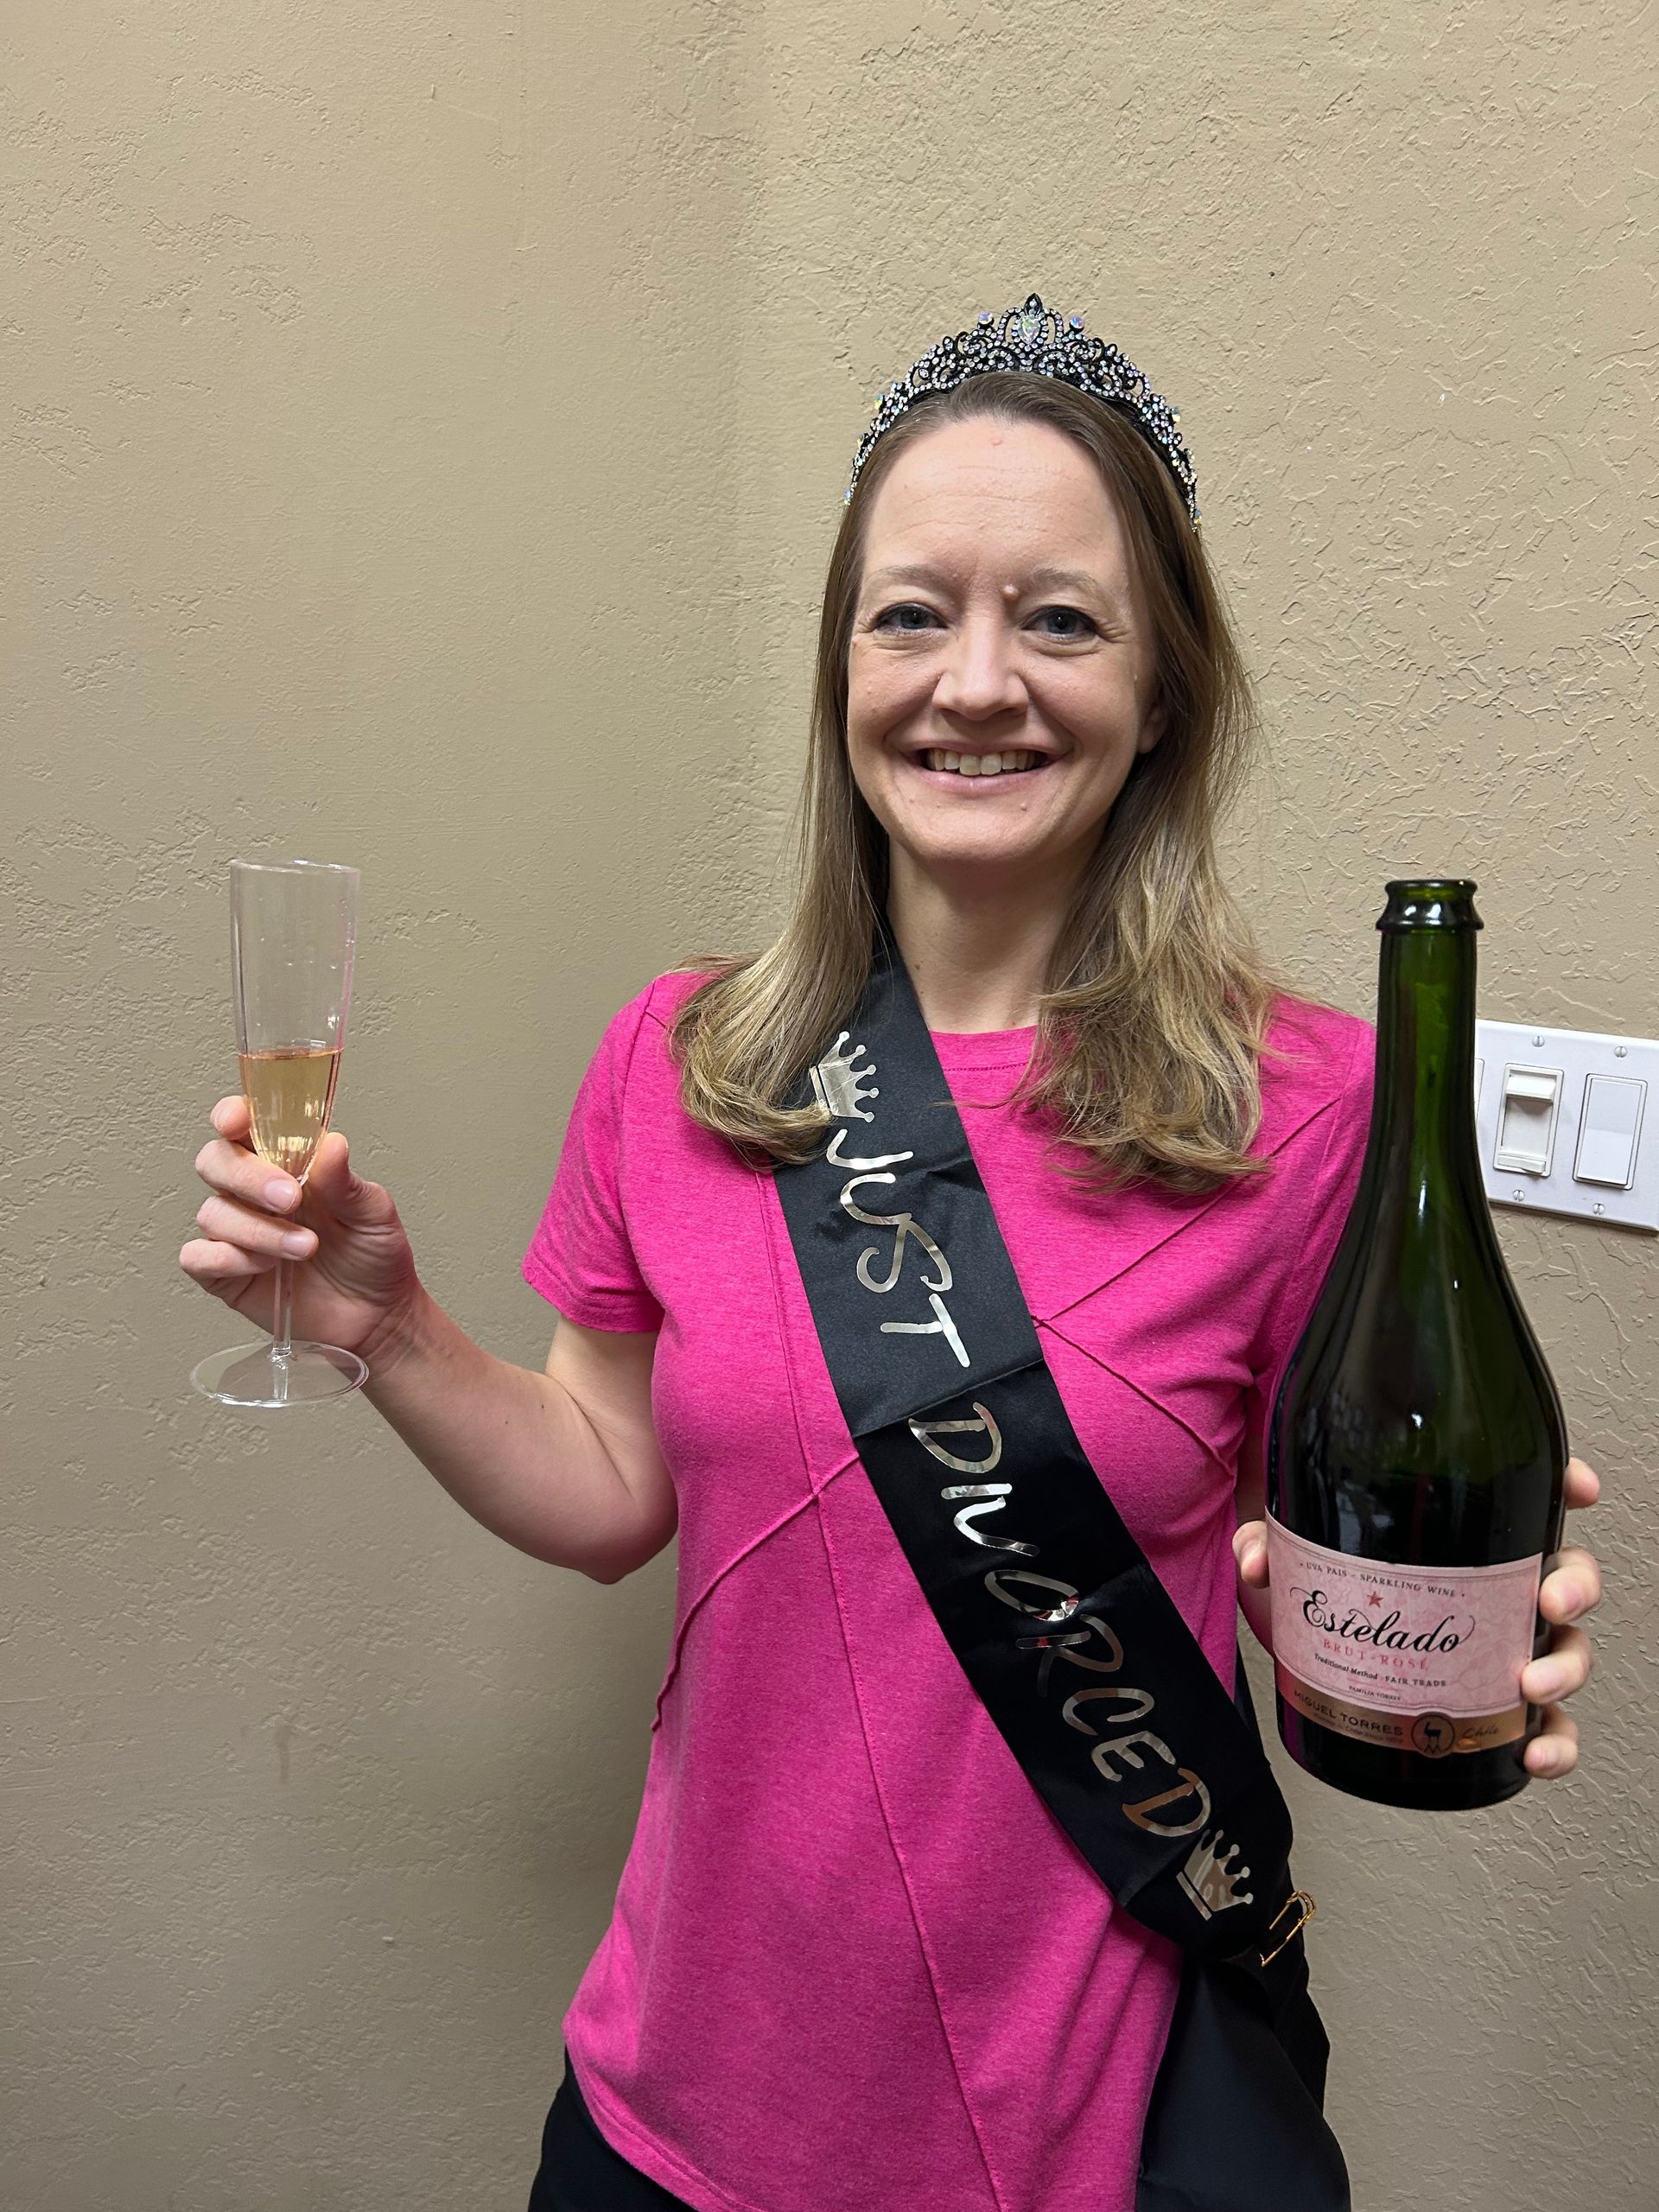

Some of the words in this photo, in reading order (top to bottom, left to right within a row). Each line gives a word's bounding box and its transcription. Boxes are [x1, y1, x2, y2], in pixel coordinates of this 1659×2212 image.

[826, 1128, 970, 1368] JUST
[1359, 1573, 1421, 1592] SPARKLING
[1427, 1585, 1456, 1598] WINE
[908, 1402, 1211, 1838] DIVORCED
[1289, 1586, 1476, 1653] Estelado
[1314, 1652, 1350, 1673] Traditional
[1351, 1667, 1378, 1681] Method
[1384, 1675, 1408, 1686] FAIR
[1413, 1678, 1447, 1688] TRADE
[1294, 1690, 1337, 1719] MIGUEL
[1340, 1712, 1403, 1736] TORRES
